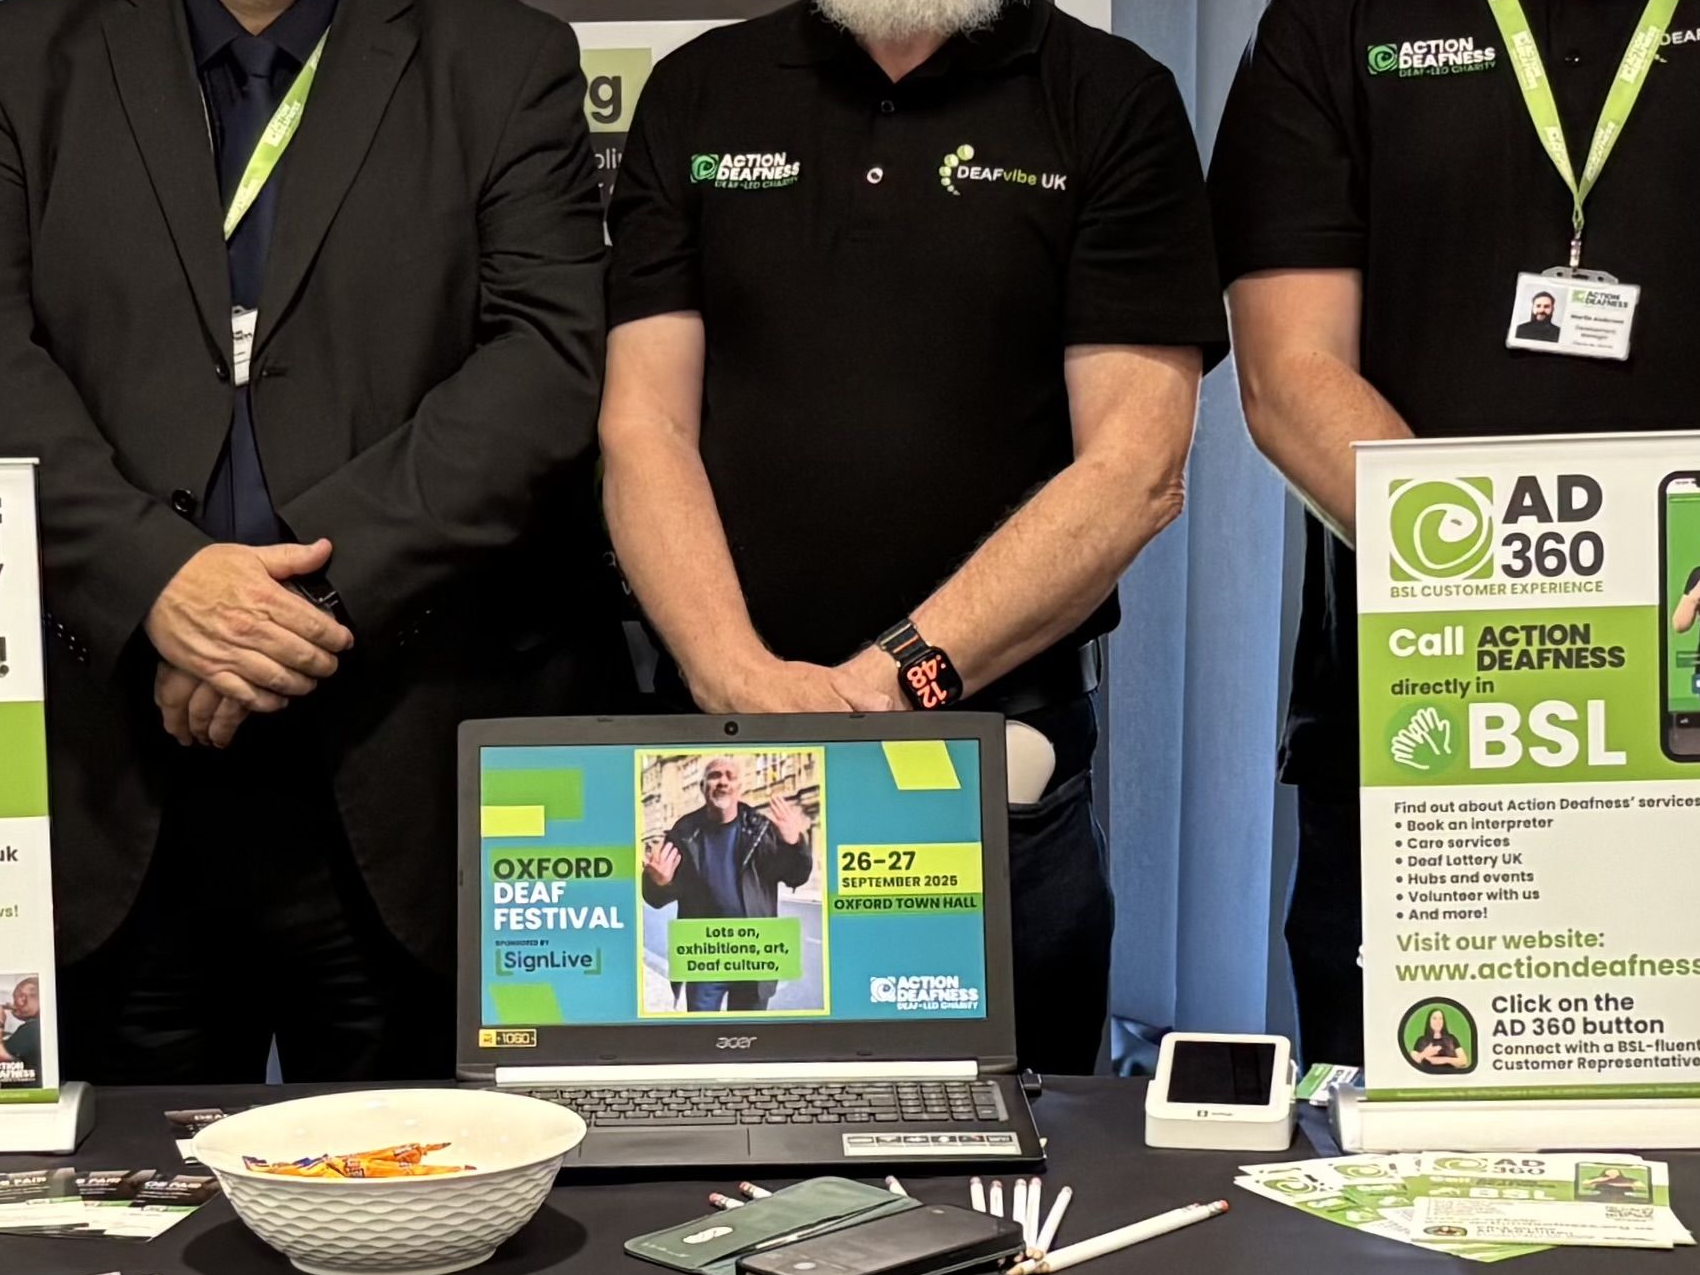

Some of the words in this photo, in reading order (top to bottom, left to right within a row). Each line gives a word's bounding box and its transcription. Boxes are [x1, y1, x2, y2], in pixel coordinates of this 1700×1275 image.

[1399, 37, 1473, 55] ACTION
[1399, 47, 1495, 69] DEAFNESS
[720, 152, 786, 168] ACTION
[717, 163, 799, 181] DEAFNESS
[957, 166, 1036, 185] DEAFvibe
[1042, 173, 1067, 191] UK
[1502, 473, 1602, 525] AD
[1501, 531, 1604, 579] 360
[1390, 586, 1417, 598] BSL
[1421, 583, 1505, 597] CUSTOMER
[1510, 580, 1604, 594] EXPERIENCE
[1389, 625, 1464, 657] Call
[1478, 623, 1591, 648] ACTION
[1477, 646, 1624, 672] DEAFNESS
[1391, 674, 1471, 699] directly
[1475, 677, 1494, 695] in
[1468, 699, 1627, 770] BSL
[1394, 800, 1423, 814] Find
[1429, 801, 1453, 813] out
[1458, 799, 1501, 813] about
[1507, 797, 1553, 812] Action
[1407, 818, 1441, 831] Book
[1446, 820, 1465, 831] an
[1471, 816, 1553, 832] interpreter
[493, 857, 613, 881] OXFORD
[842, 851, 916, 871] 26-27
[1408, 855, 1443, 867] Deaf
[1446, 854, 1497, 870] Lottery
[1502, 853, 1522, 866] UK
[843, 876, 919, 889] SEPTEMBER
[925, 875, 957, 887] 2025
[494, 881, 564, 904] DEAF
[834, 898, 891, 910] OXFORD
[895, 897, 937, 910] TOWN
[942, 896, 977, 909] HALL
[494, 906, 623, 930] FESTIVAL
[705, 926, 733, 940] Lots
[738, 927, 759, 941] on,
[1397, 933, 1449, 952] Visit
[1454, 934, 1496, 951] our
[1503, 930, 1605, 950] website:
[677, 940, 759, 956] exhibitions,
[764, 941, 789, 956] art,
[504, 950, 592, 970] SignLive
[687, 958, 720, 972] Deaf
[725, 958, 779, 973] culture,
[897, 975, 959, 990] ACTION
[896, 988, 978, 1002] DEAFNESS
[1492, 994, 1549, 1014] Click
[1558, 995, 1586, 1013] on
[1592, 993, 1633, 1011] the
[1492, 1019, 1526, 1037] AD
[1532, 1018, 1576, 1035] 360
[1583, 1016, 1664, 1034] button
[717, 1036, 757, 1049] acer
[1469, 1187, 1556, 1201] BSL
